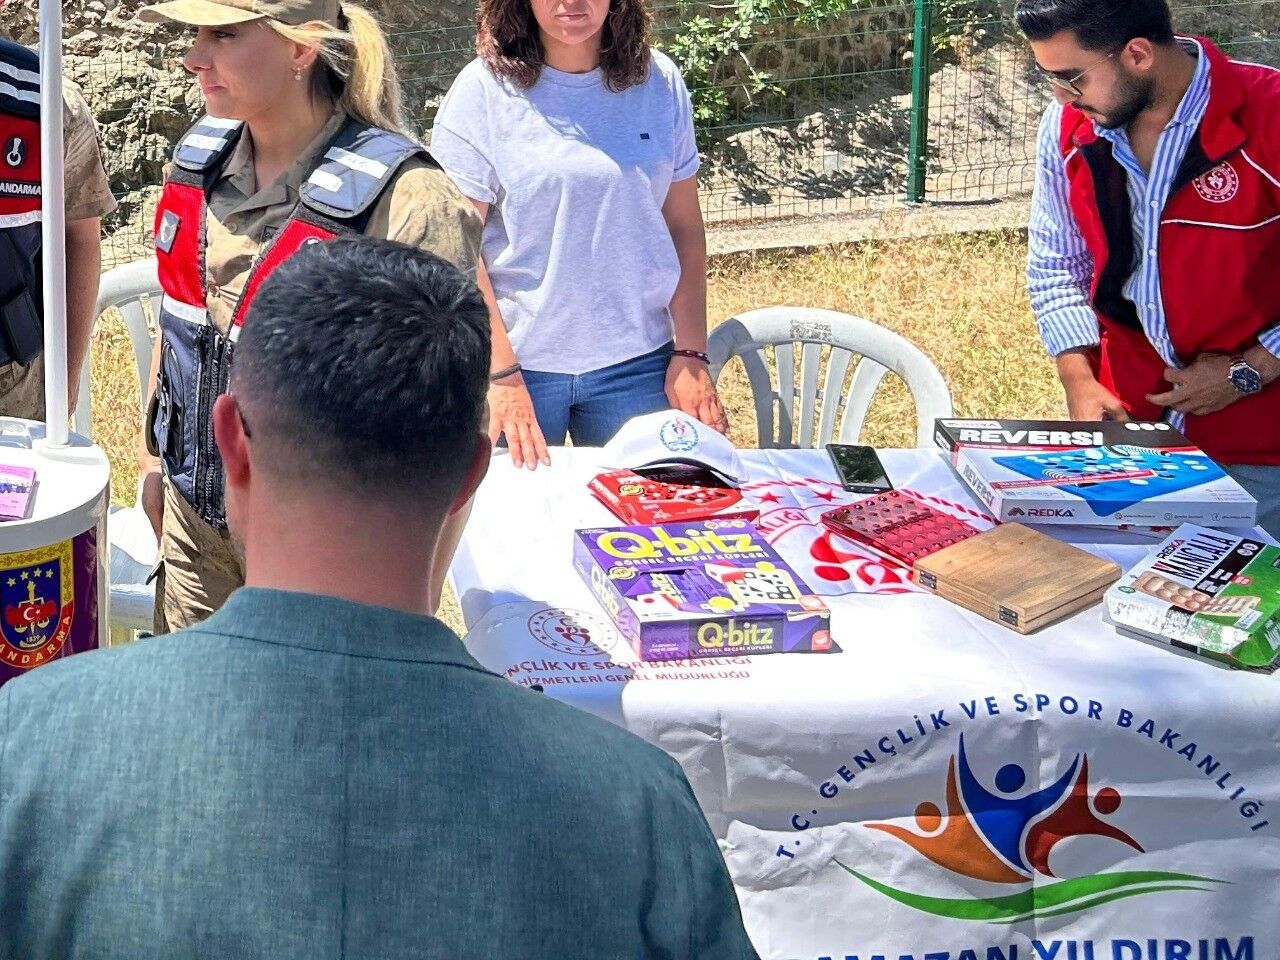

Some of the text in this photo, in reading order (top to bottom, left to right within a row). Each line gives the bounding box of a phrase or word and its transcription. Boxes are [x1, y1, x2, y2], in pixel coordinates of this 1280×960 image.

[959, 428, 1104, 446] REVERSI
[1028, 508, 1074, 518] REDKA
[1151, 533, 1238, 582] MANCALA
[563, 661, 590, 671] VE
[593, 661, 644, 670] SPOR
[519, 674, 603, 685] HİZMETLERİ
[605, 673, 650, 682] GENEL
[776, 693, 1270, 859] T.C. GENÇLİK VE SPOR BAKANLIĞI
